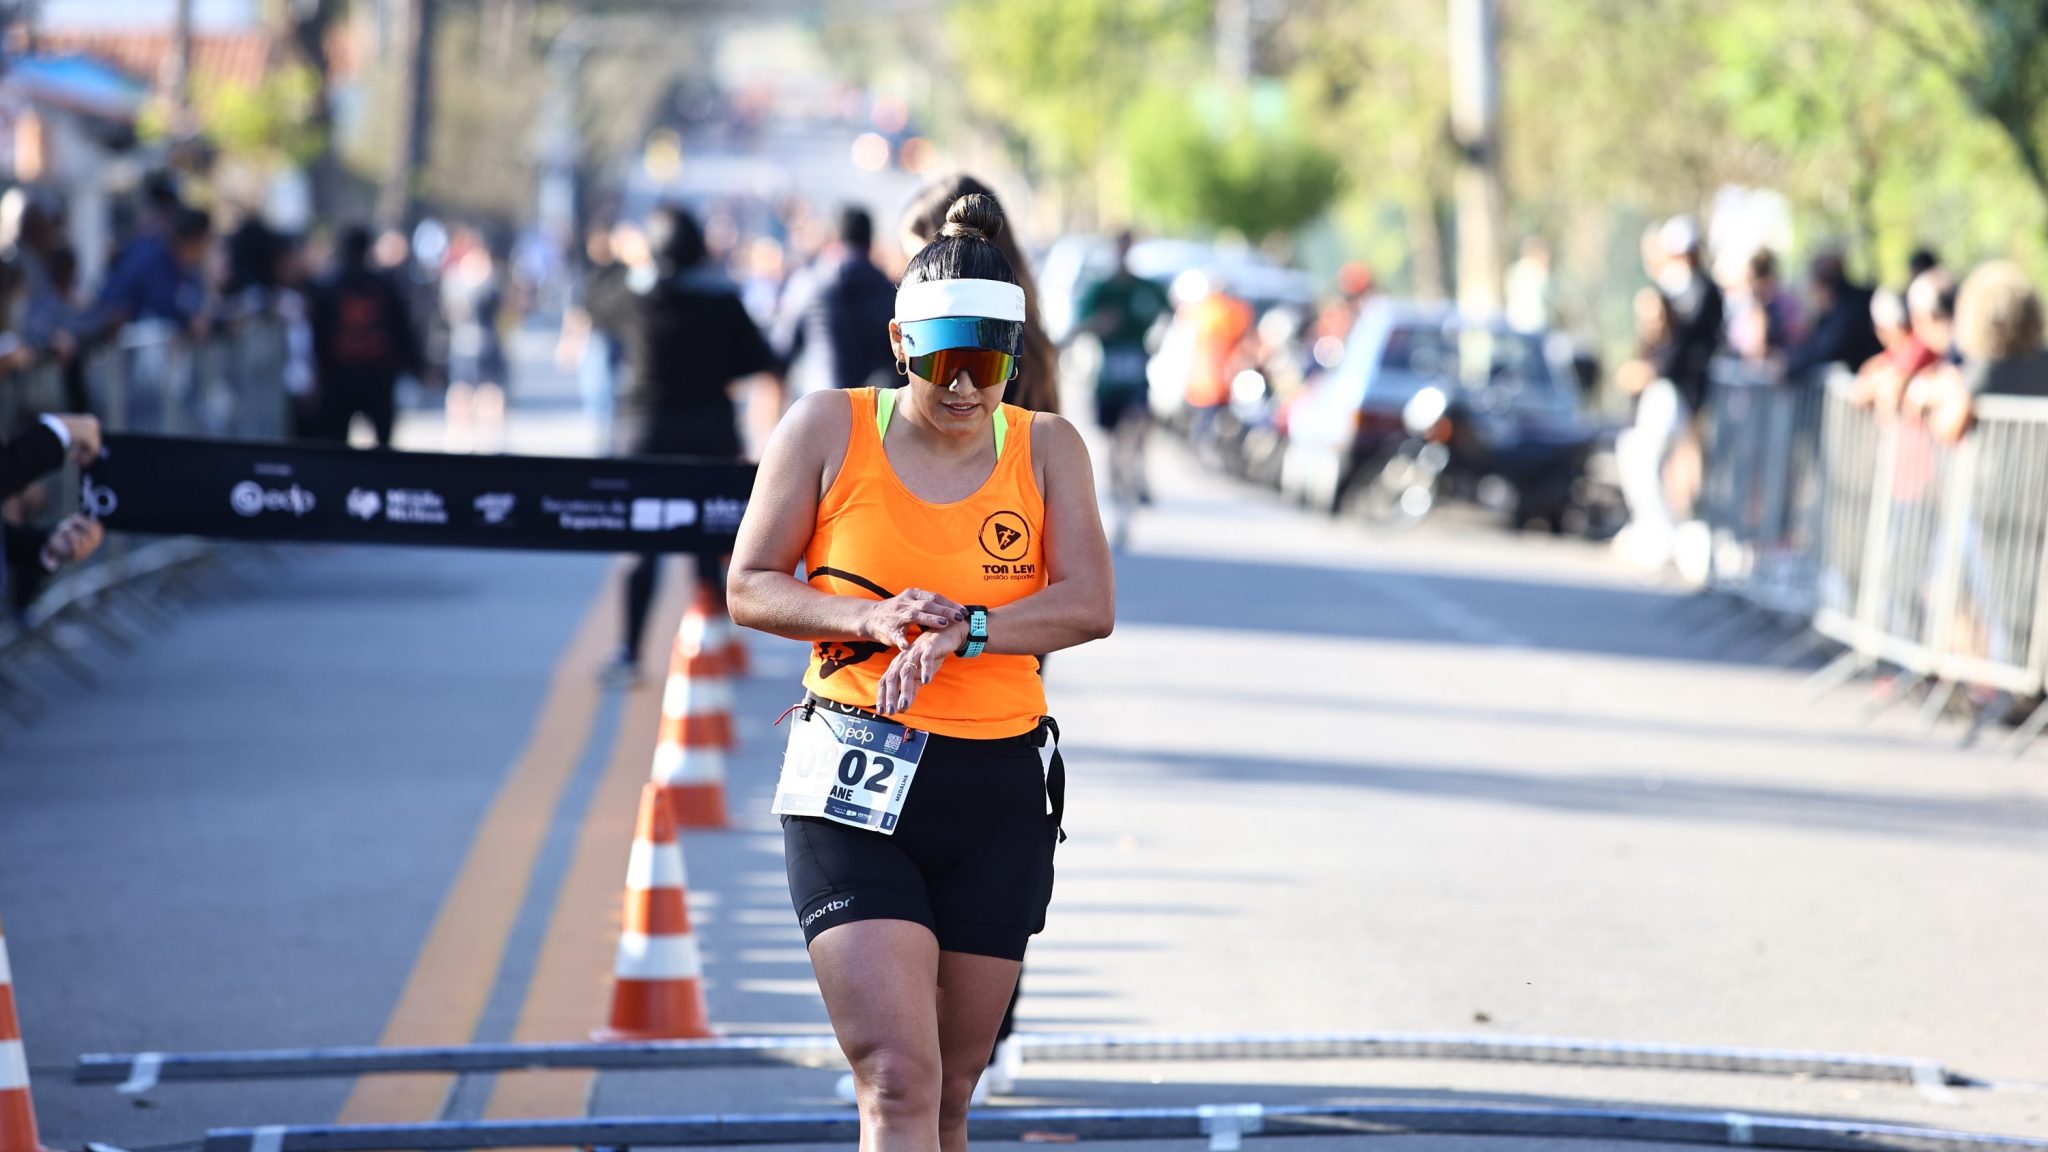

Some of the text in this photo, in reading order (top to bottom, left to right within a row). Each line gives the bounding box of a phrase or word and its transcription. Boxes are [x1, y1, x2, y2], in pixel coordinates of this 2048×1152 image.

[982, 564, 1035, 574] TON LEVI
[845, 726, 874, 745] edp
[895, 774, 908, 802] MEDALHA
